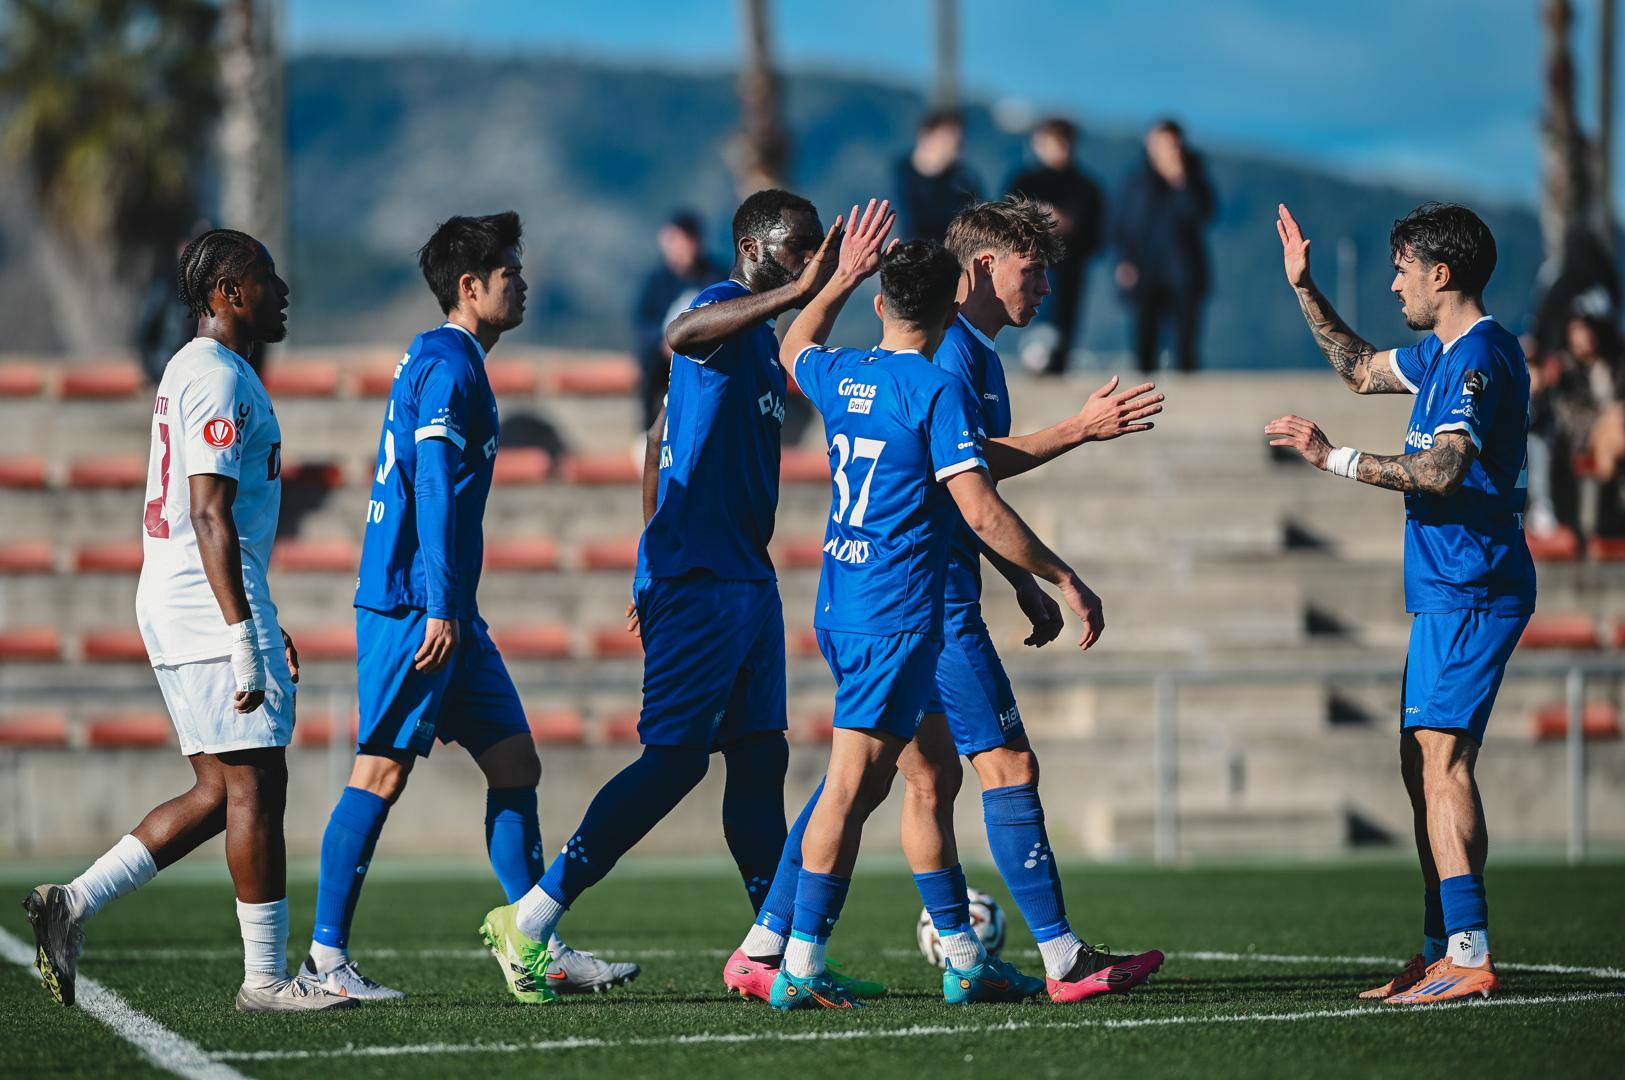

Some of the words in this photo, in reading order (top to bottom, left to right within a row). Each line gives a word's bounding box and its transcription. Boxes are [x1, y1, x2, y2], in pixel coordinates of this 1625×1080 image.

[838, 377, 878, 399] Circus
[850, 400, 870, 413] Daily
[829, 433, 887, 528] 37
